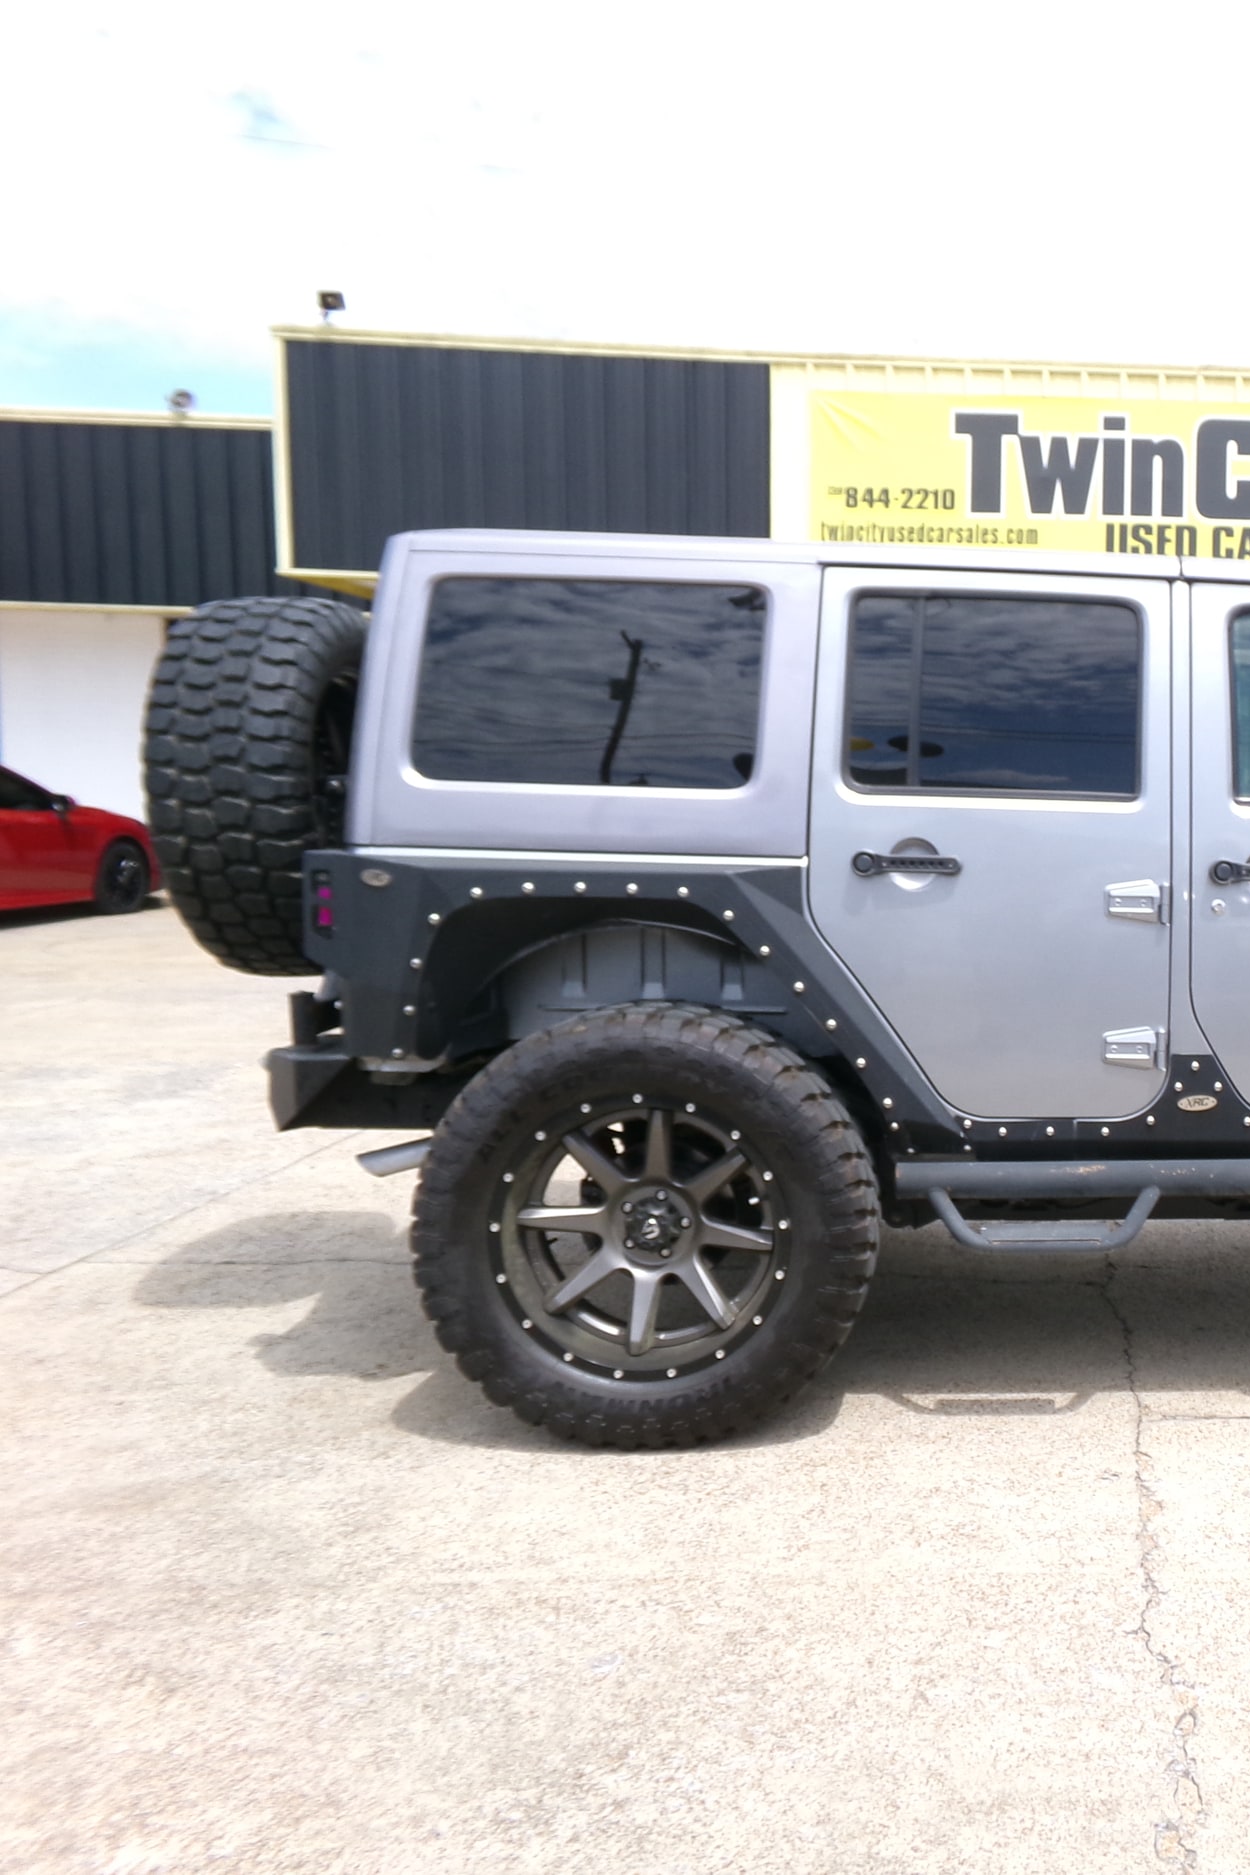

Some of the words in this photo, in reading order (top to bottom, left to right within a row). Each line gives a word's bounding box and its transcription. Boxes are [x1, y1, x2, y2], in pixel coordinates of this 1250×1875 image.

[955, 413, 1184, 517] Twin
[820, 520, 1039, 545] twincityusedcarsales.com
[1105, 523, 1198, 557] USED
